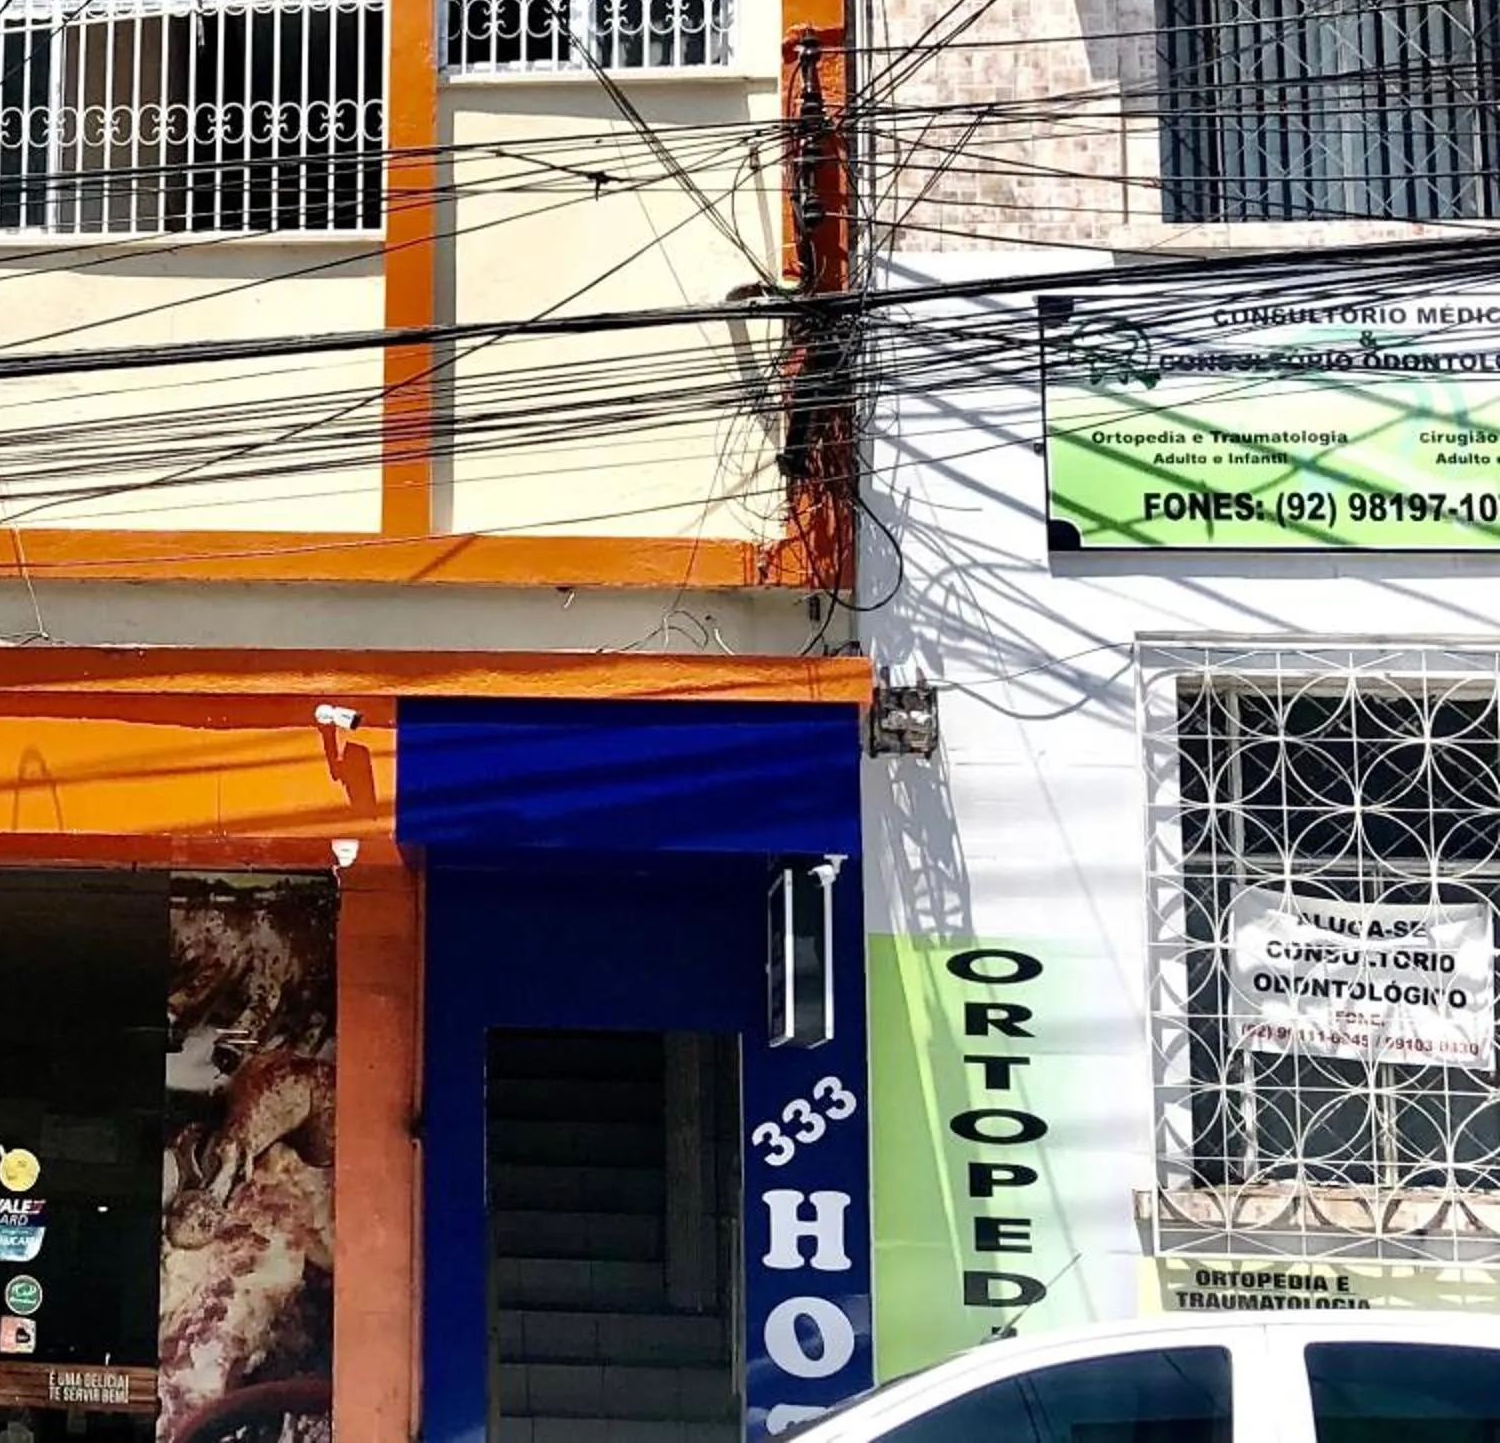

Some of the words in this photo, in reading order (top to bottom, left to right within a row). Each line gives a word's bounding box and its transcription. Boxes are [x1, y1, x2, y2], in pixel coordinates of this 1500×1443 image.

[1363, 351, 1500, 372] ODONTOL
[1092, 430, 1186, 446] Ortopedia
[1192, 432, 1204, 444] e
[1210, 430, 1348, 446] Traumatologia
[1153, 452, 1207, 465] Adulto
[1213, 455, 1222, 465] e
[1228, 452, 1288, 465] Infantil
[1436, 452, 1491, 465] Adulto
[1144, 492, 1264, 521] FONES:
[1276, 491, 1337, 527] (92)
[1349, 492, 1500, 522] 98197-10
[751, 1076, 857, 1167] 333
[946, 949, 1049, 1339] ORTOPED
[1195, 1269, 1329, 1292] ORTOPEDIA
[1338, 1275, 1350, 1292] E
